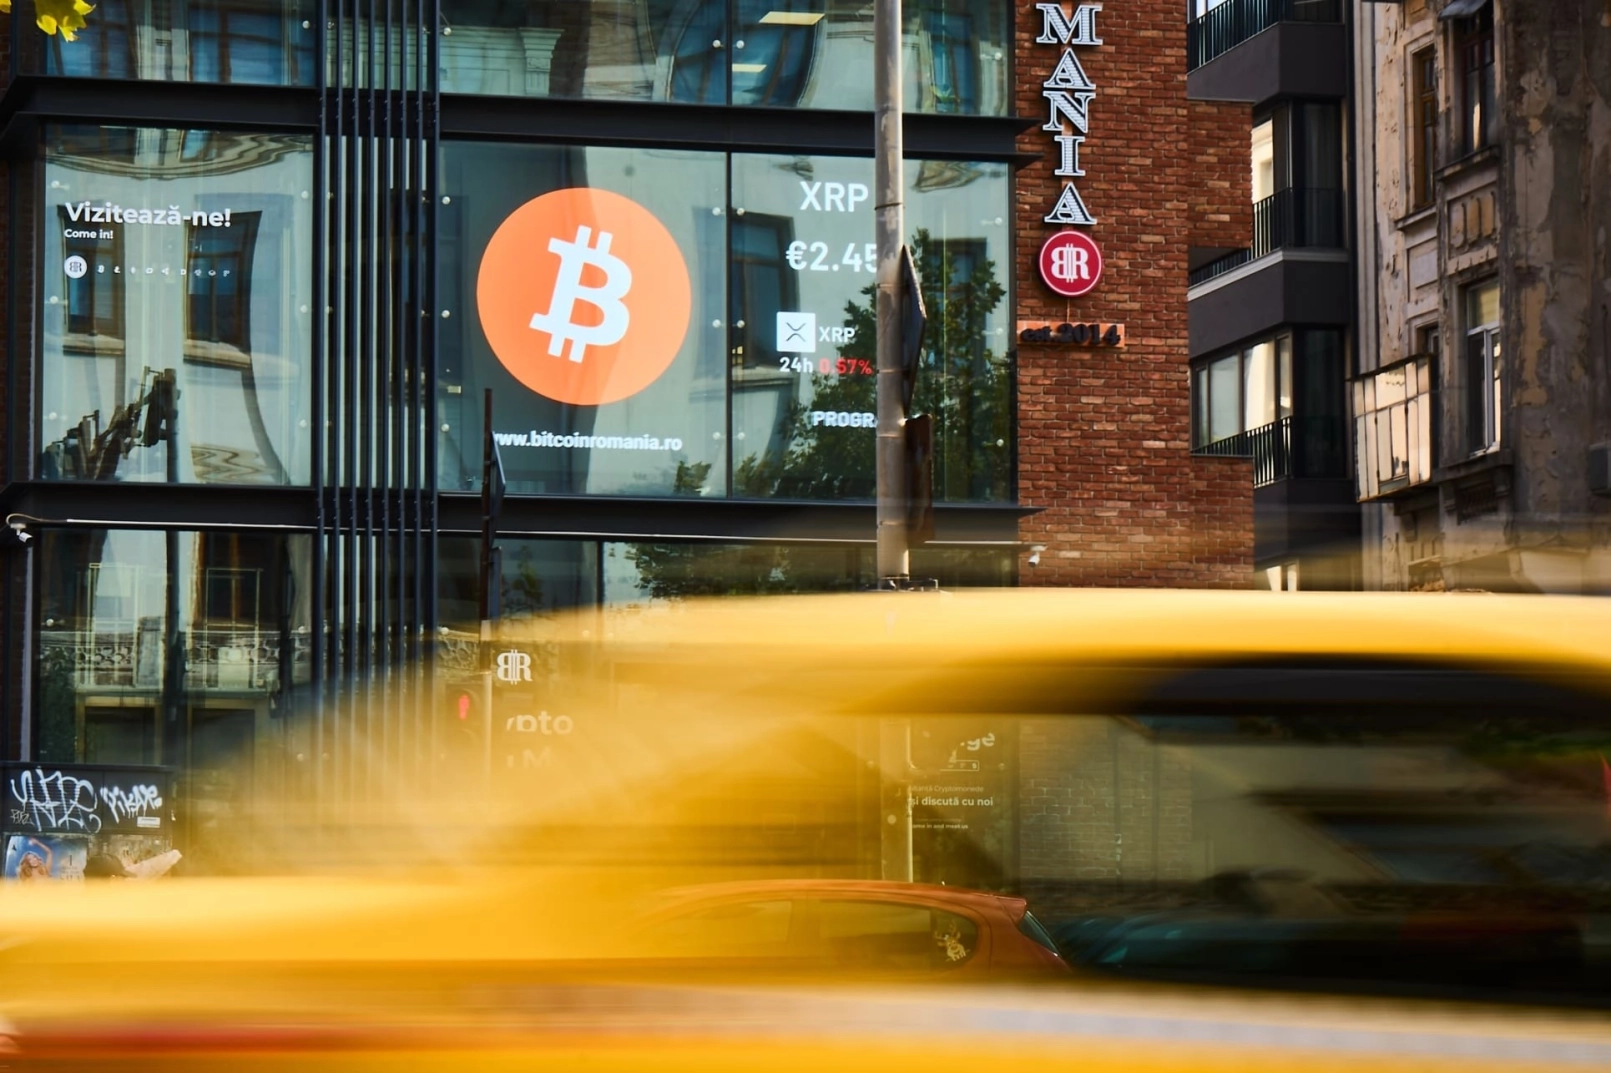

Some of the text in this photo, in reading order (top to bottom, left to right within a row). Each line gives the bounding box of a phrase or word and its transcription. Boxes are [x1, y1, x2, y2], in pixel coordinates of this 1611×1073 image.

[800, 182, 869, 212] XRP
[65, 201, 231, 228] Vizitează-ne!
[64, 229, 114, 239] Come in!
[819, 327, 855, 342] XRP
[779, 357, 873, 375] 24h 0.57%
[921, 796, 959, 806] discută
[962, 798, 975, 806] cu
[977, 796, 994, 806] noi
